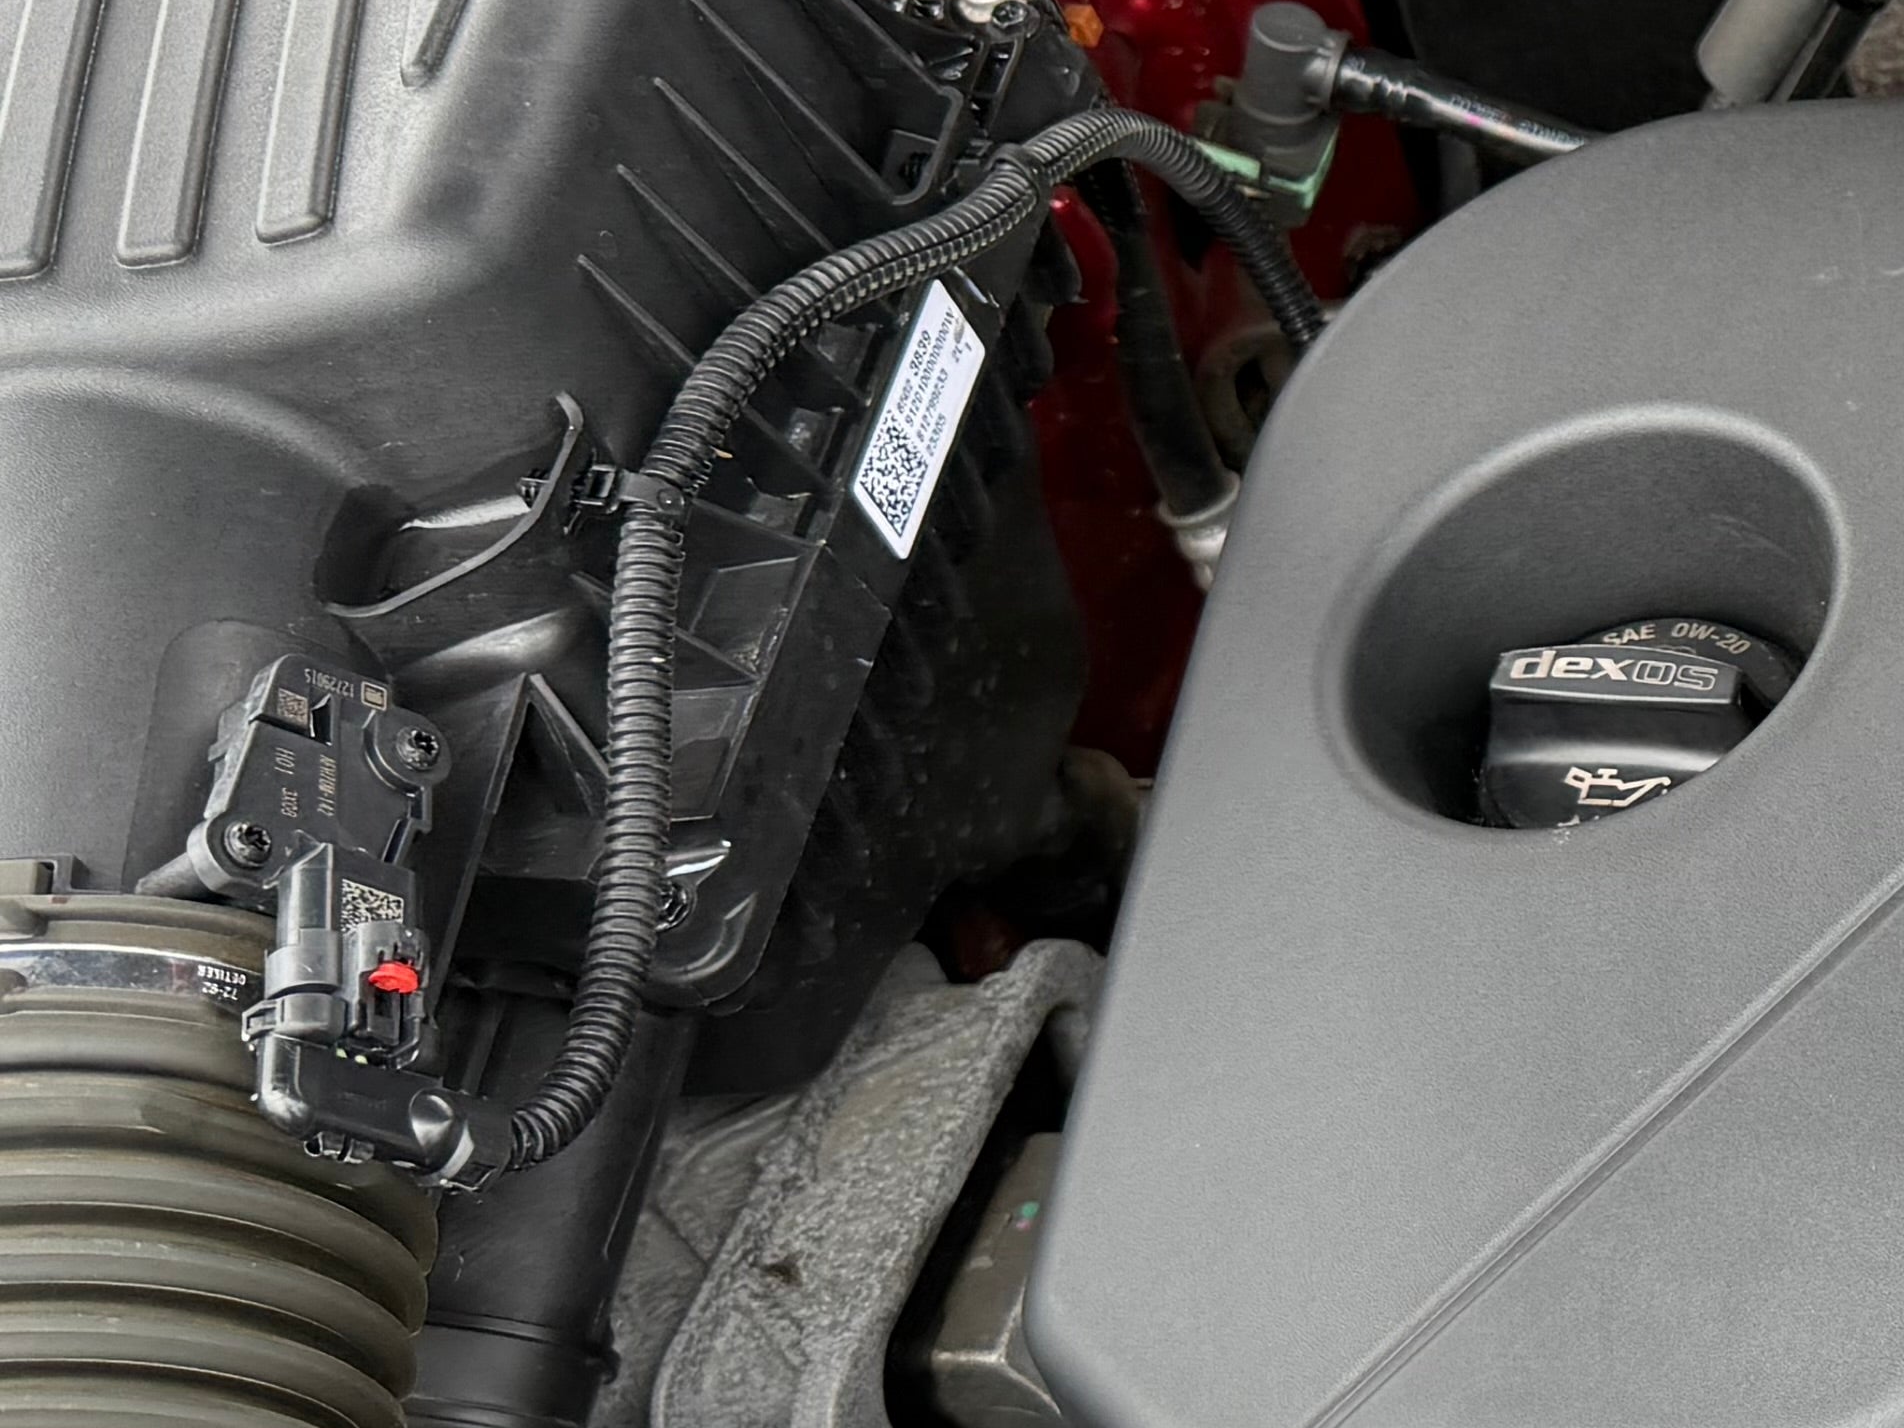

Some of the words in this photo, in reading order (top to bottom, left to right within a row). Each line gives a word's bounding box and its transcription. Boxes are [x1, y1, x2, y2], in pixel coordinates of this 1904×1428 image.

[1603, 623, 1656, 646] SAE
[1669, 621, 1751, 655] 0W-20
[1510, 650, 1719, 691] dexos
